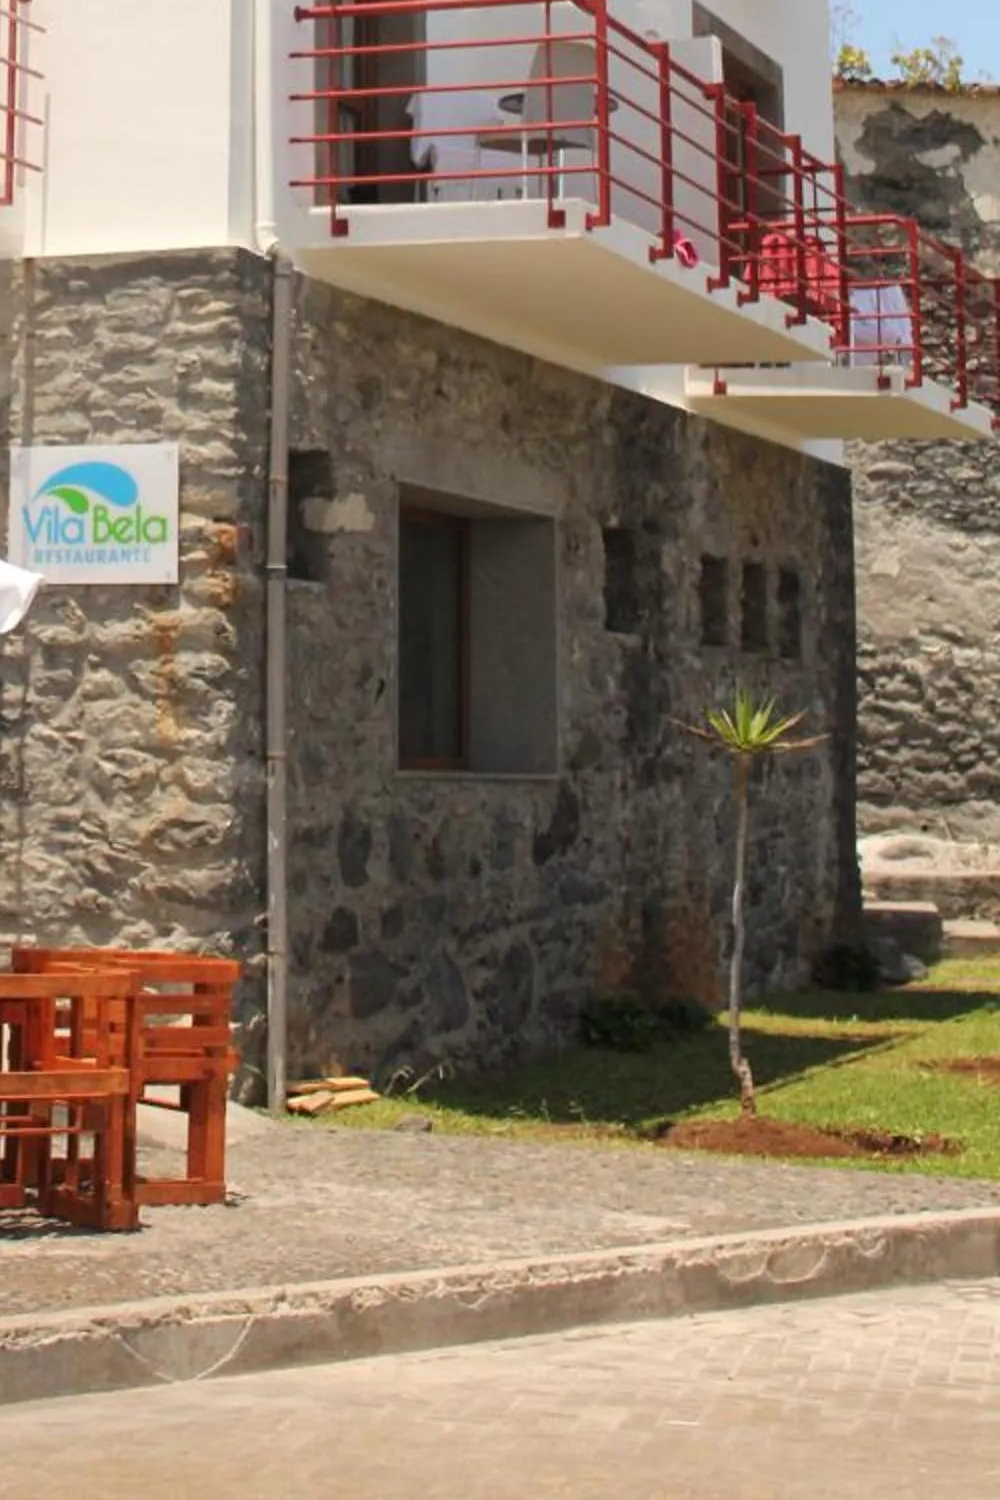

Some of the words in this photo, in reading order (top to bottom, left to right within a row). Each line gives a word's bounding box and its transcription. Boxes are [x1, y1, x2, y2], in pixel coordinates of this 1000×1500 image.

[21, 504, 85, 545] Vila
[92, 503, 168, 545] Bela
[33, 548, 152, 565] RESTAURANTE
